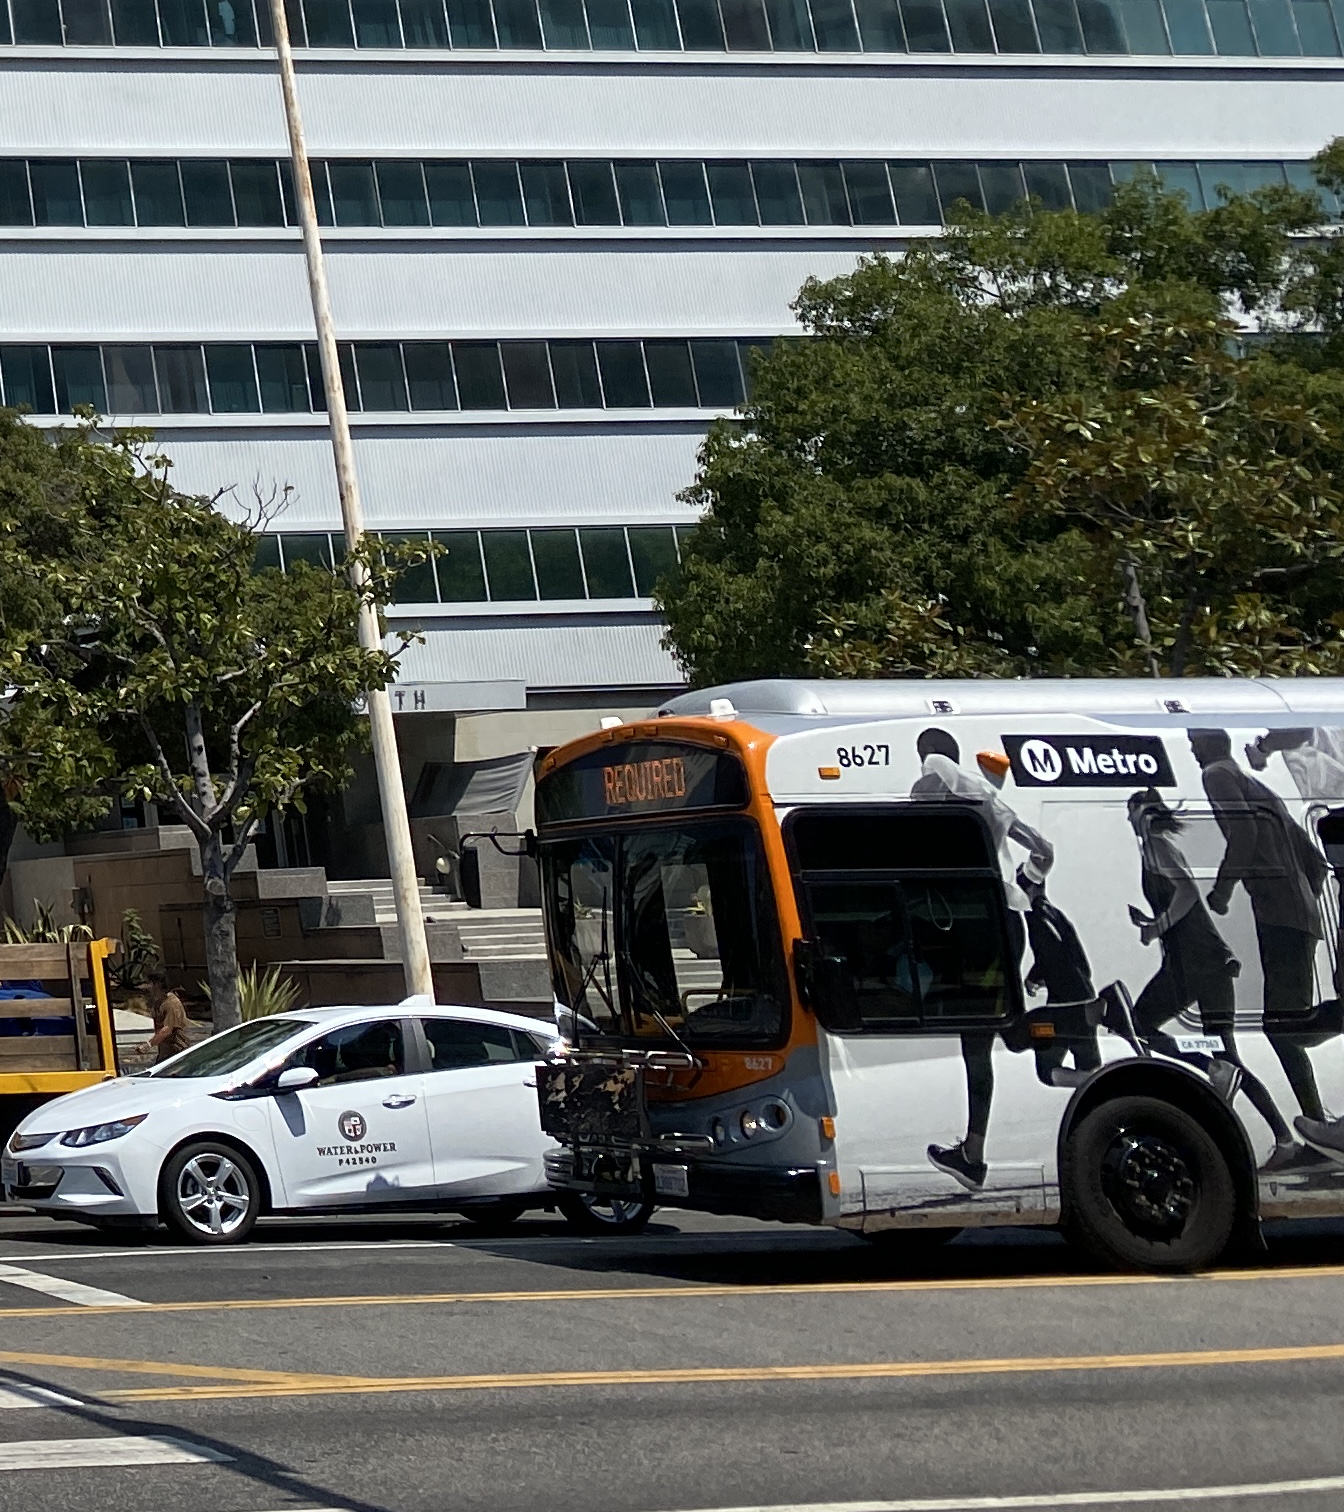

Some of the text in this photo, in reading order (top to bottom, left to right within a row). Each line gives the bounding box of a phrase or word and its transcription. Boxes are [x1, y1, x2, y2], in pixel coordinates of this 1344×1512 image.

[837, 744, 890, 768] 8627
[1065, 746, 1158, 775] Metro
[604, 757, 685, 805] REQUIRED
[744, 1057, 772, 1070] 8627
